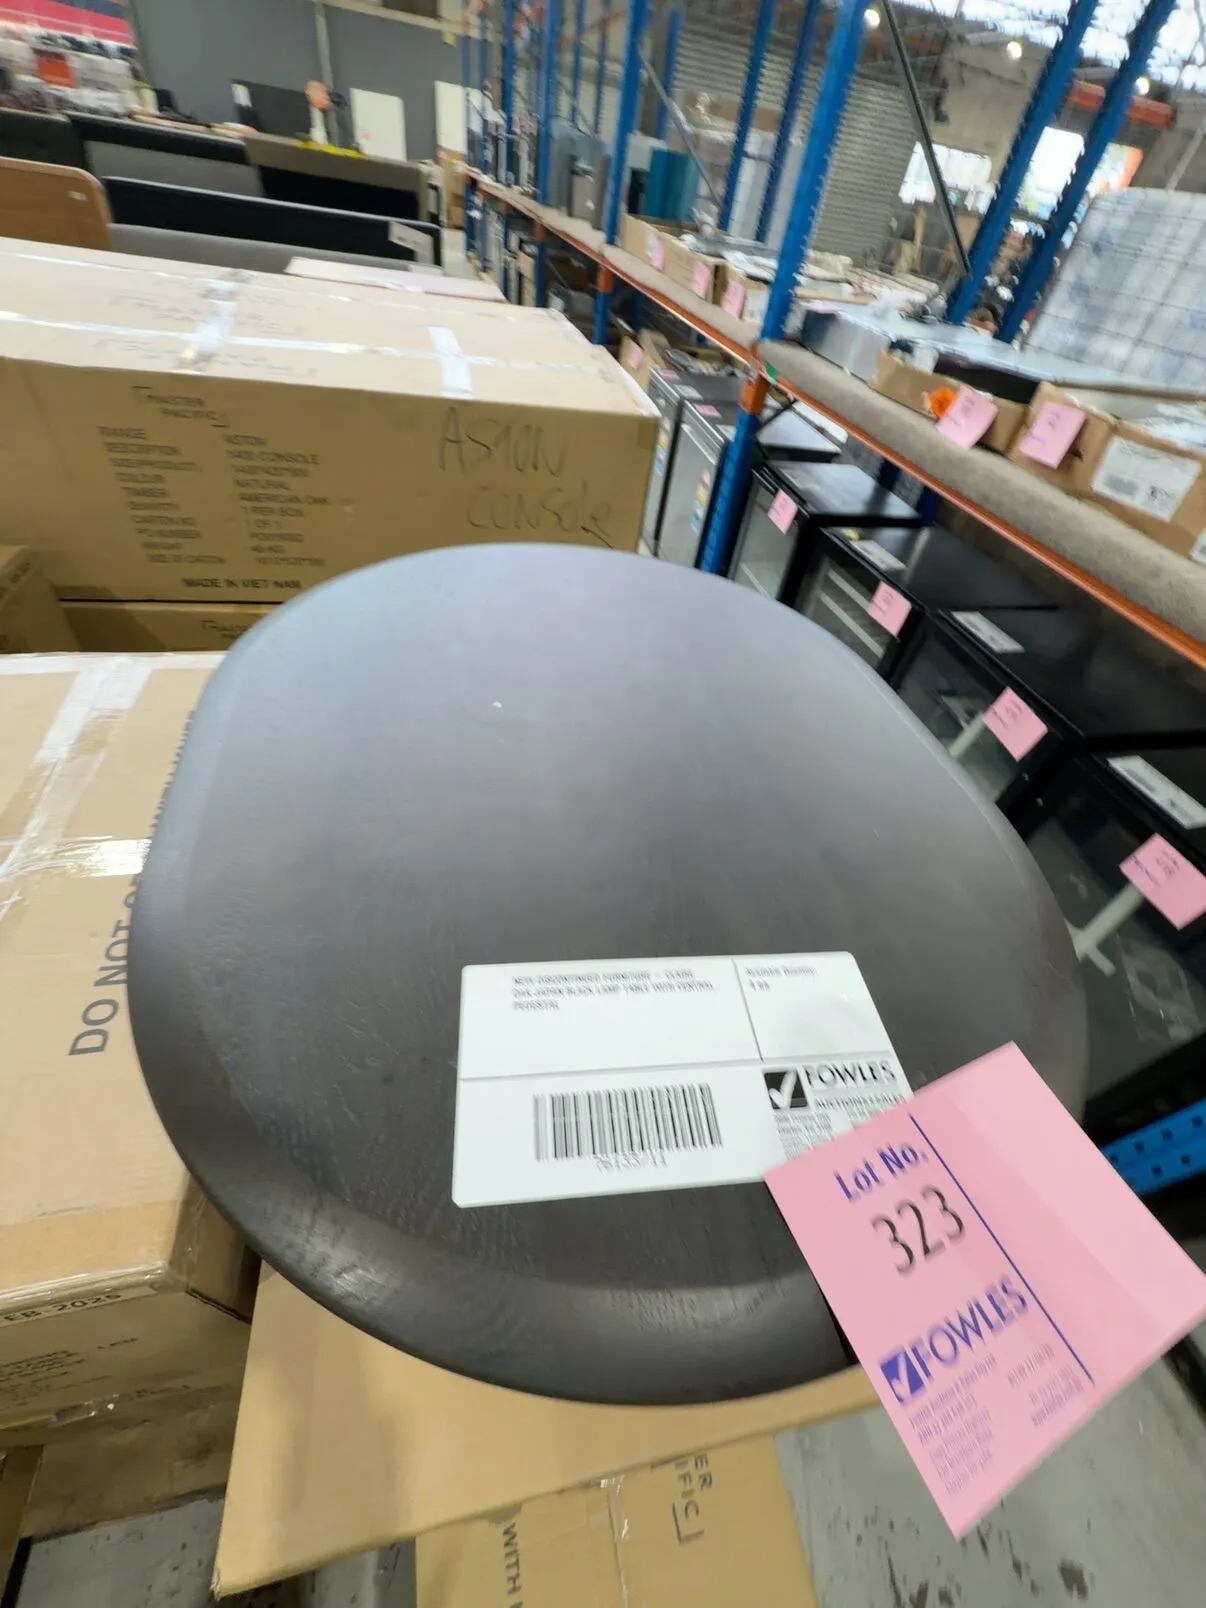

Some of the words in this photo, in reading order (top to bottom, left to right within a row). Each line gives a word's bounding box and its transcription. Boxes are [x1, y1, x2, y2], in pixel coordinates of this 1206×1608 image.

[259, 451, 320, 465] CONSOLE
[182, 578, 222, 588] MADE
[224, 579, 239, 588] IN
[242, 579, 269, 589] VIET
[273, 579, 303, 589] NAM
[69, 999, 119, 1056] DO
[802, 1060, 898, 1088] FOWLES
[834, 1157, 884, 1202] Lot
[877, 1143, 929, 1177] No.
[871, 1184, 965, 1276] 323
[908, 1274, 1029, 1384] FOWLES
[503, 1522, 522, 1598] WITH
